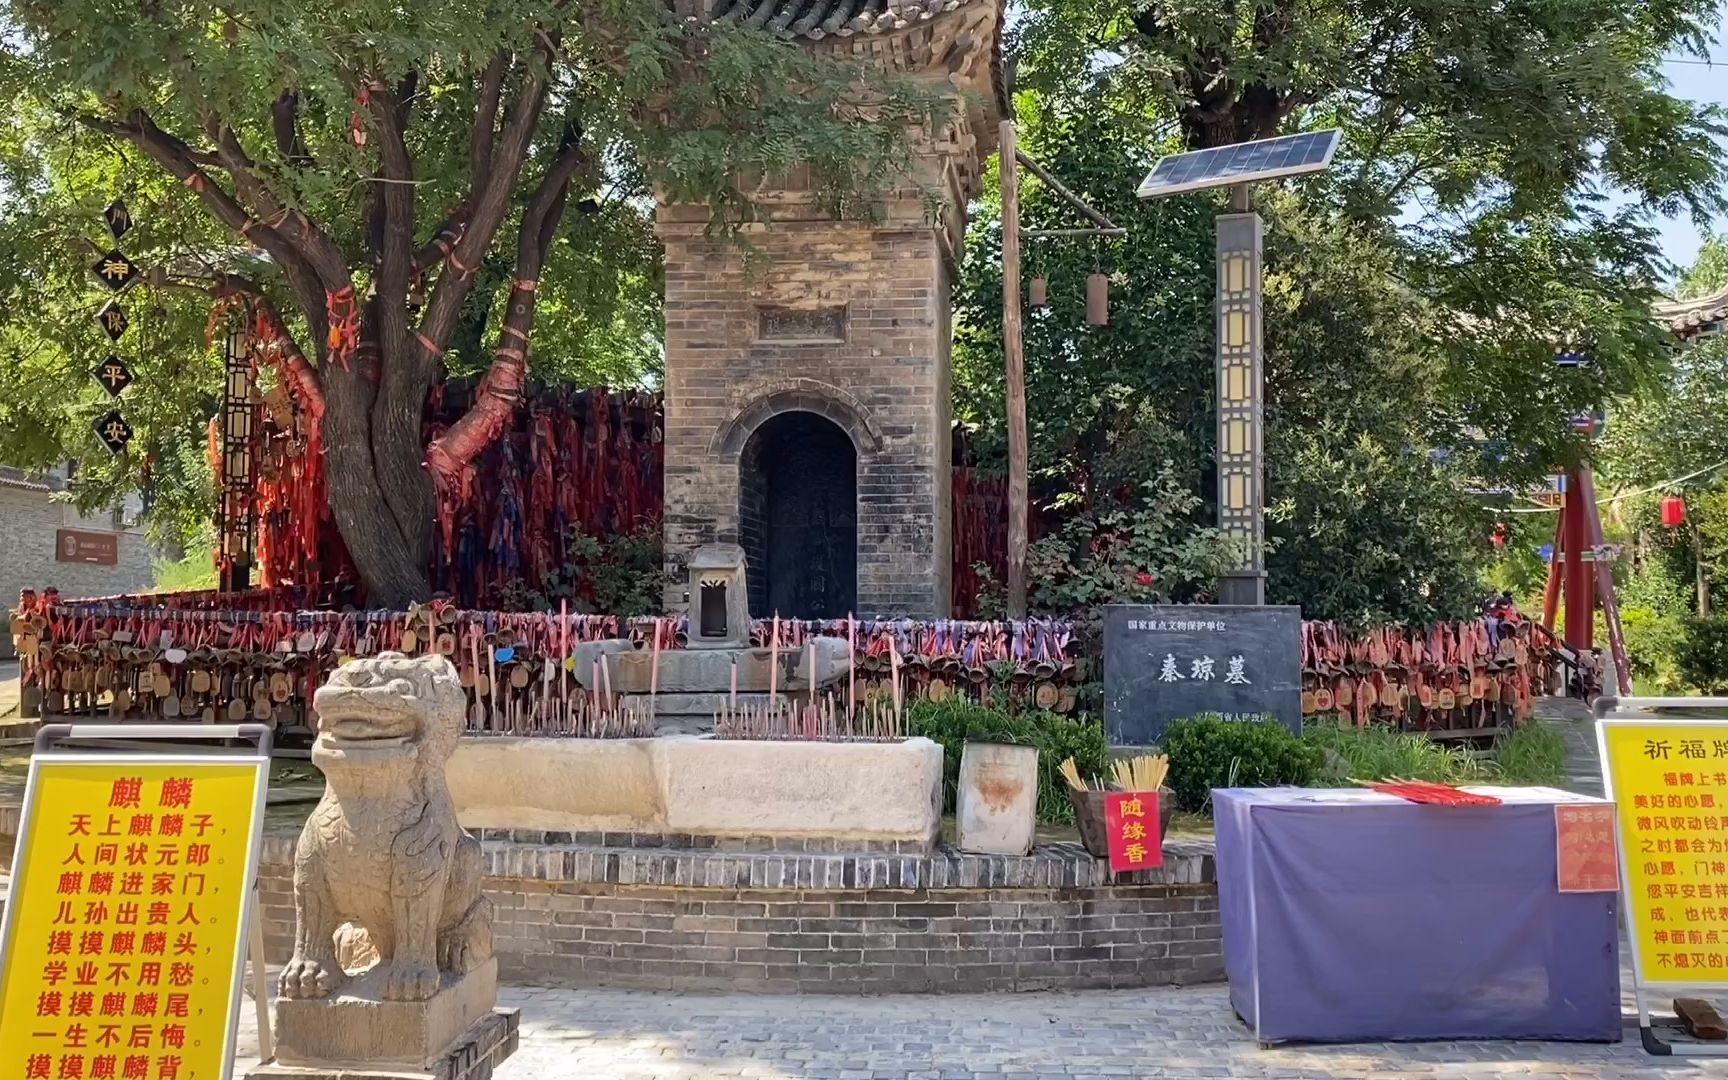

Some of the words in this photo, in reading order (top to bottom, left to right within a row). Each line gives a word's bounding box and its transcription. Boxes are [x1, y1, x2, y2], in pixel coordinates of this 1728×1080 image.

[1128, 620, 1226, 632] 国家重点文物保护单位
[1158, 653, 1252, 685] 秦琼墓
[1663, 772, 1728, 787] 福牌上书
[108, 777, 194, 809] 麒麟
[68, 814, 227, 838] 天上麒麟子，
[1120, 798, 1149, 864] 随缘香
[62, 843, 225, 867] 人间状元郎。
[56, 872, 220, 896] 麒麟进家门，
[52, 901, 217, 926] 儿孙出贵人。
[47, 931, 211, 956] 摸摸麒麟头，
[1656, 952, 1728, 968] 不熄灭的
[42, 960, 209, 987] 学业不用愁。
[36, 992, 204, 1017] 摸摸麒麟尾，
[32, 1023, 200, 1050] 一生不后悔。
[25, 1054, 195, 1080] 摸摸麒麟背，
